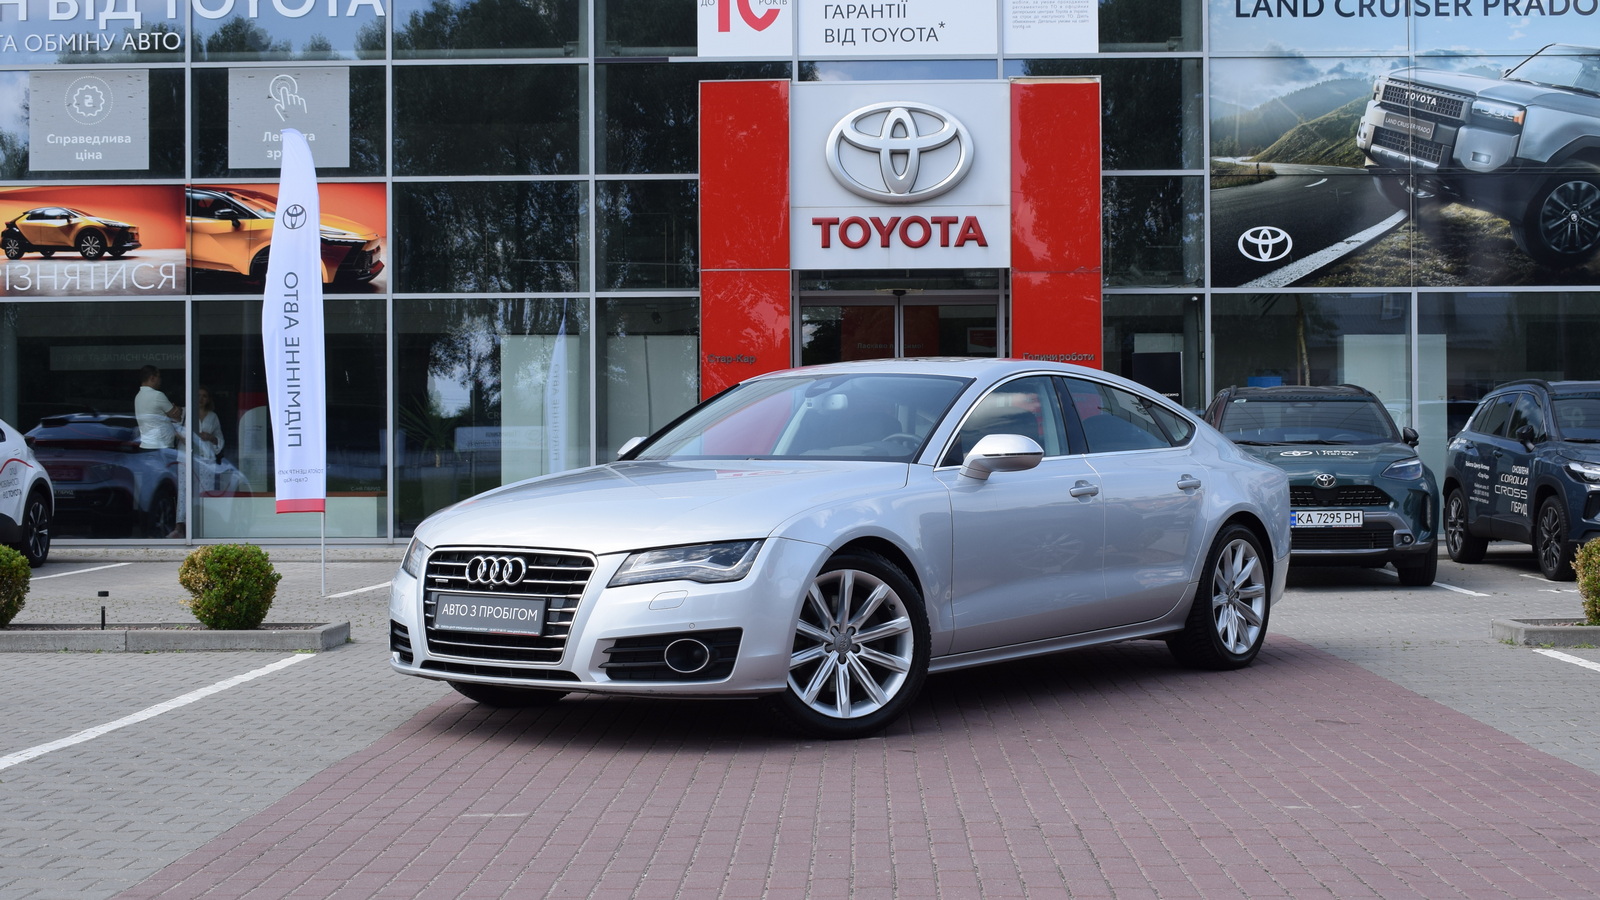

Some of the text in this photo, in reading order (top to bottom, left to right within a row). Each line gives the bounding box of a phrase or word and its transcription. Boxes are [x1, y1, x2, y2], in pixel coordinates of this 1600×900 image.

[824, 0, 907, 19] ГАРАНТІЇ
[1235, 0, 1599, 18] LAND CRUISER PRADO
[24, 33, 116, 52] ОБМІНУ
[122, 32, 181, 51] АВТО
[824, 28, 856, 46] ВІД
[1405, 91, 1437, 106] TOYOTA
[1385, 117, 1397, 126] LAND
[46, 133, 131, 146] Справедлива
[75, 150, 103, 161] ціна
[811, 215, 988, 249] TOYOTA
[0, 263, 176, 291] ІЗНЯТИСЯ
[707, 353, 756, 364] Стар-Кар
[1022, 352, 1095, 363] Години роботи
[1500, 473, 1529, 487] COROLLA
[1494, 484, 1528, 500] CROSS
[1297, 512, 1360, 524] KA 7295 PH
[441, 603, 468, 616] АВТО
[479, 605, 538, 621] ПРОБІГОМ
